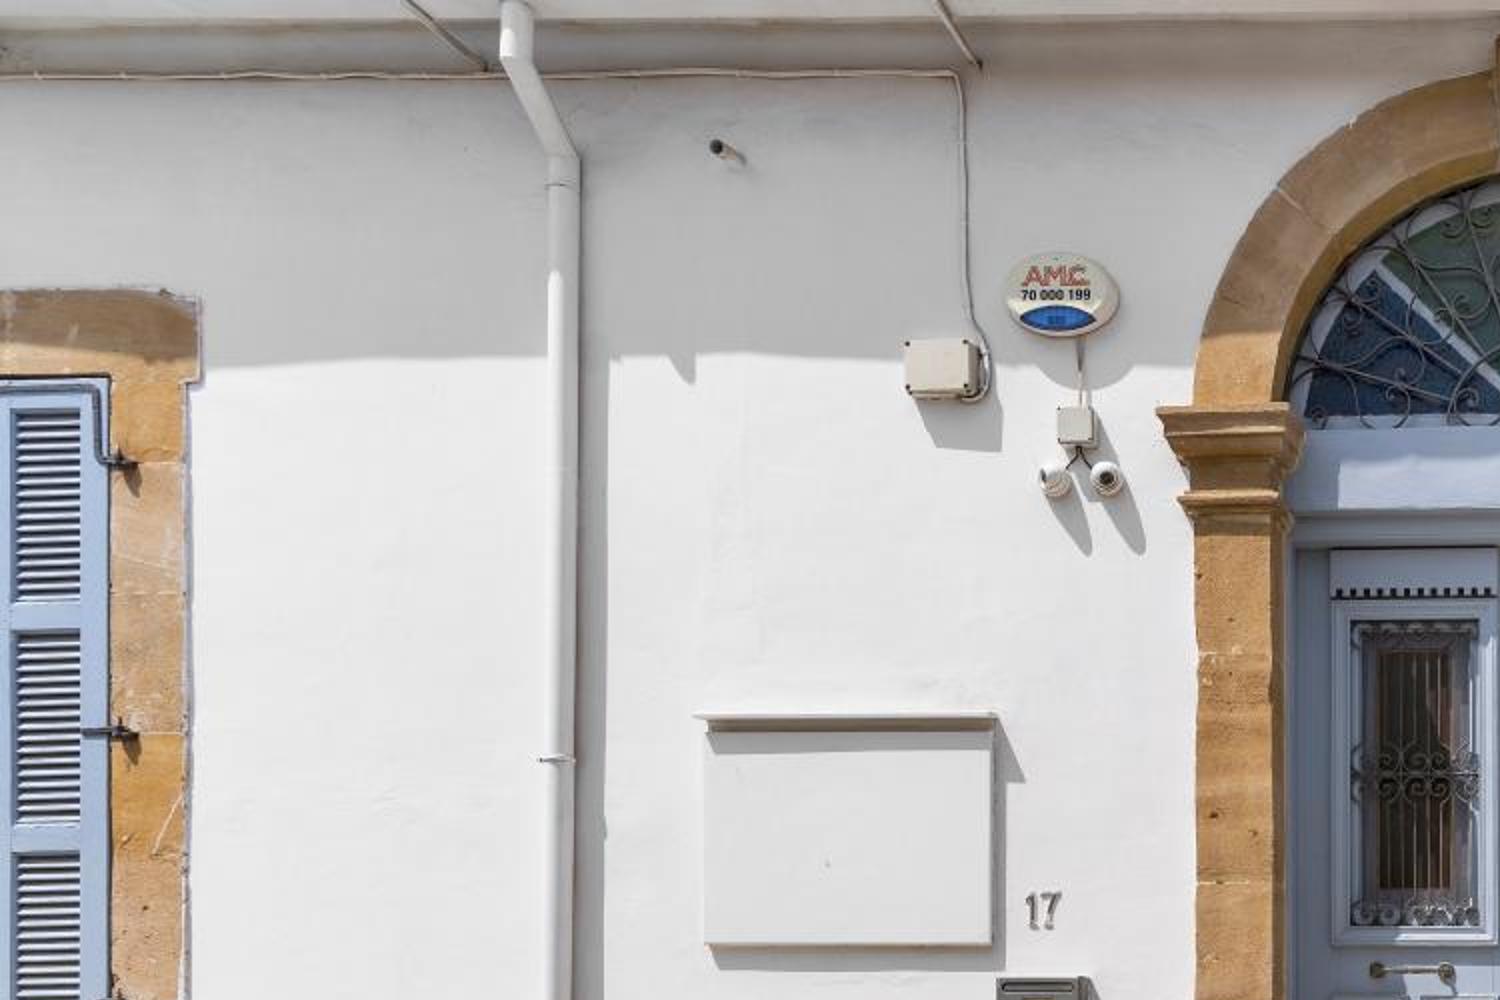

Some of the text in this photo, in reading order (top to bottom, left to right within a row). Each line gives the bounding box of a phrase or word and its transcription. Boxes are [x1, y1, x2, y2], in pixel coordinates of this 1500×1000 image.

[1021, 264, 1091, 287] AMC
[1022, 289, 1091, 301] 70 000 199
[1025, 892, 1062, 930] 17
